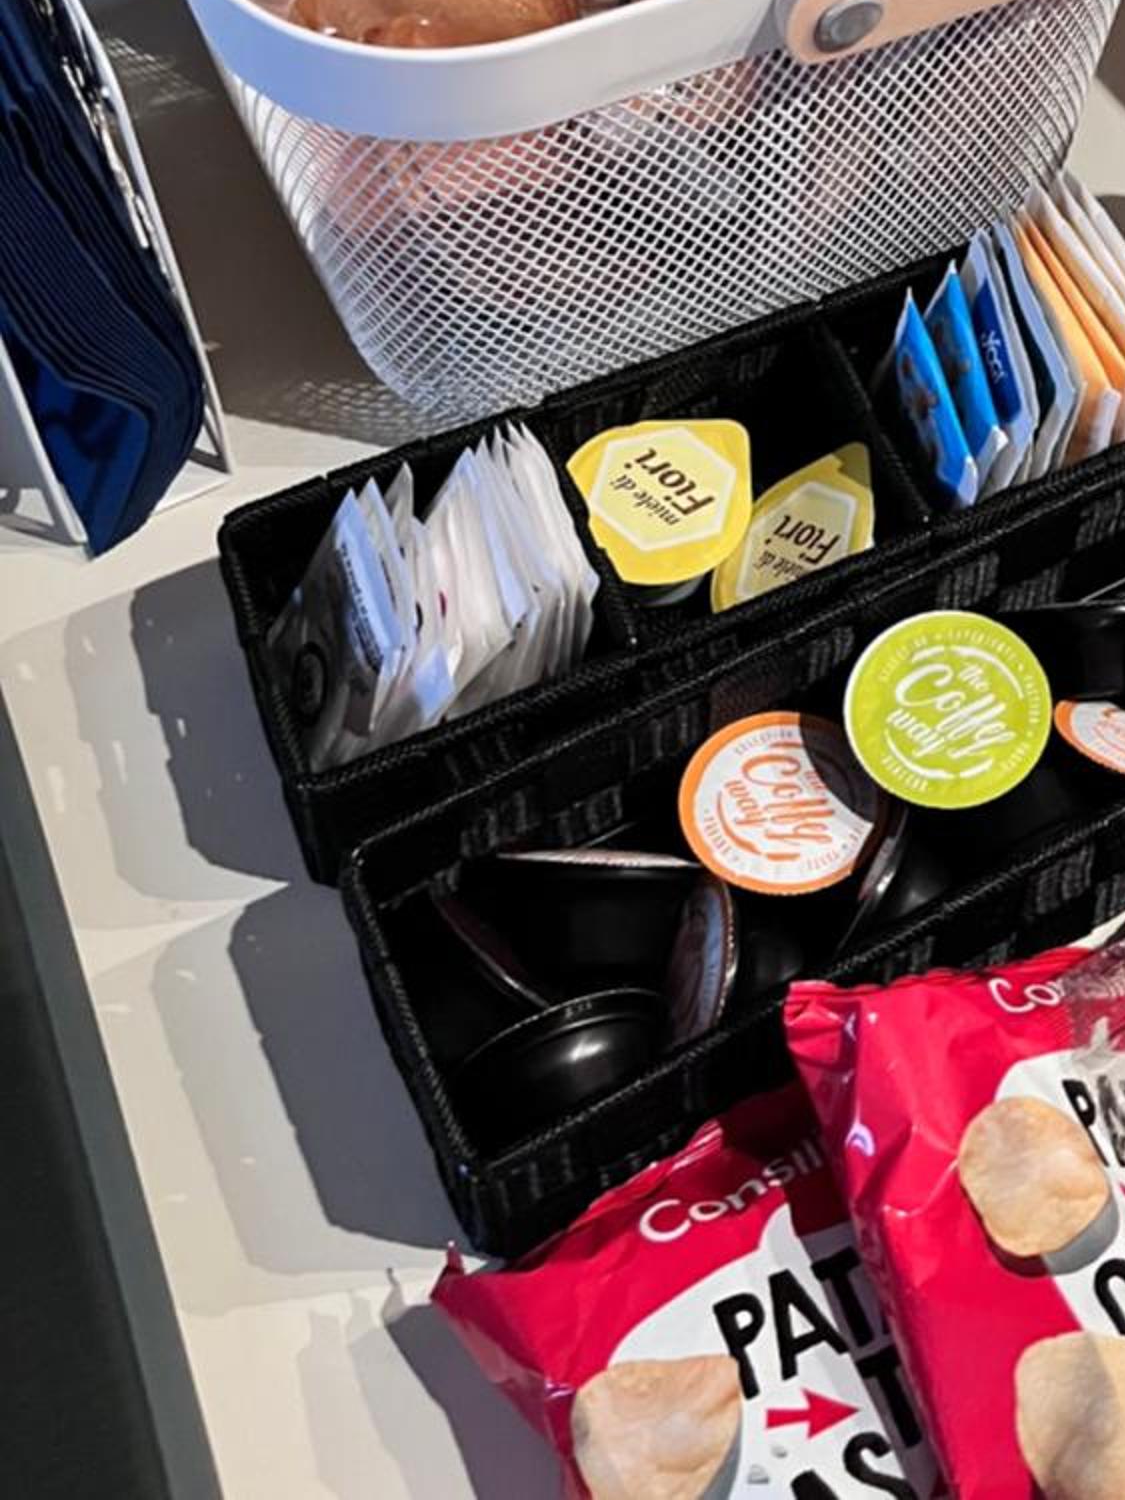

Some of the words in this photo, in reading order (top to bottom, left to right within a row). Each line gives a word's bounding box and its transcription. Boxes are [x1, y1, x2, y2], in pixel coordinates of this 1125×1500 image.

[609, 472, 635, 493] di
[624, 446, 714, 515] Fiori
[634, 491, 680, 526] miele
[765, 515, 840, 565] Fiori
[886, 708, 946, 758] way
[724, 780, 768, 826] way
[639, 1138, 826, 1242] Consil
[712, 1245, 888, 1400] PAT
